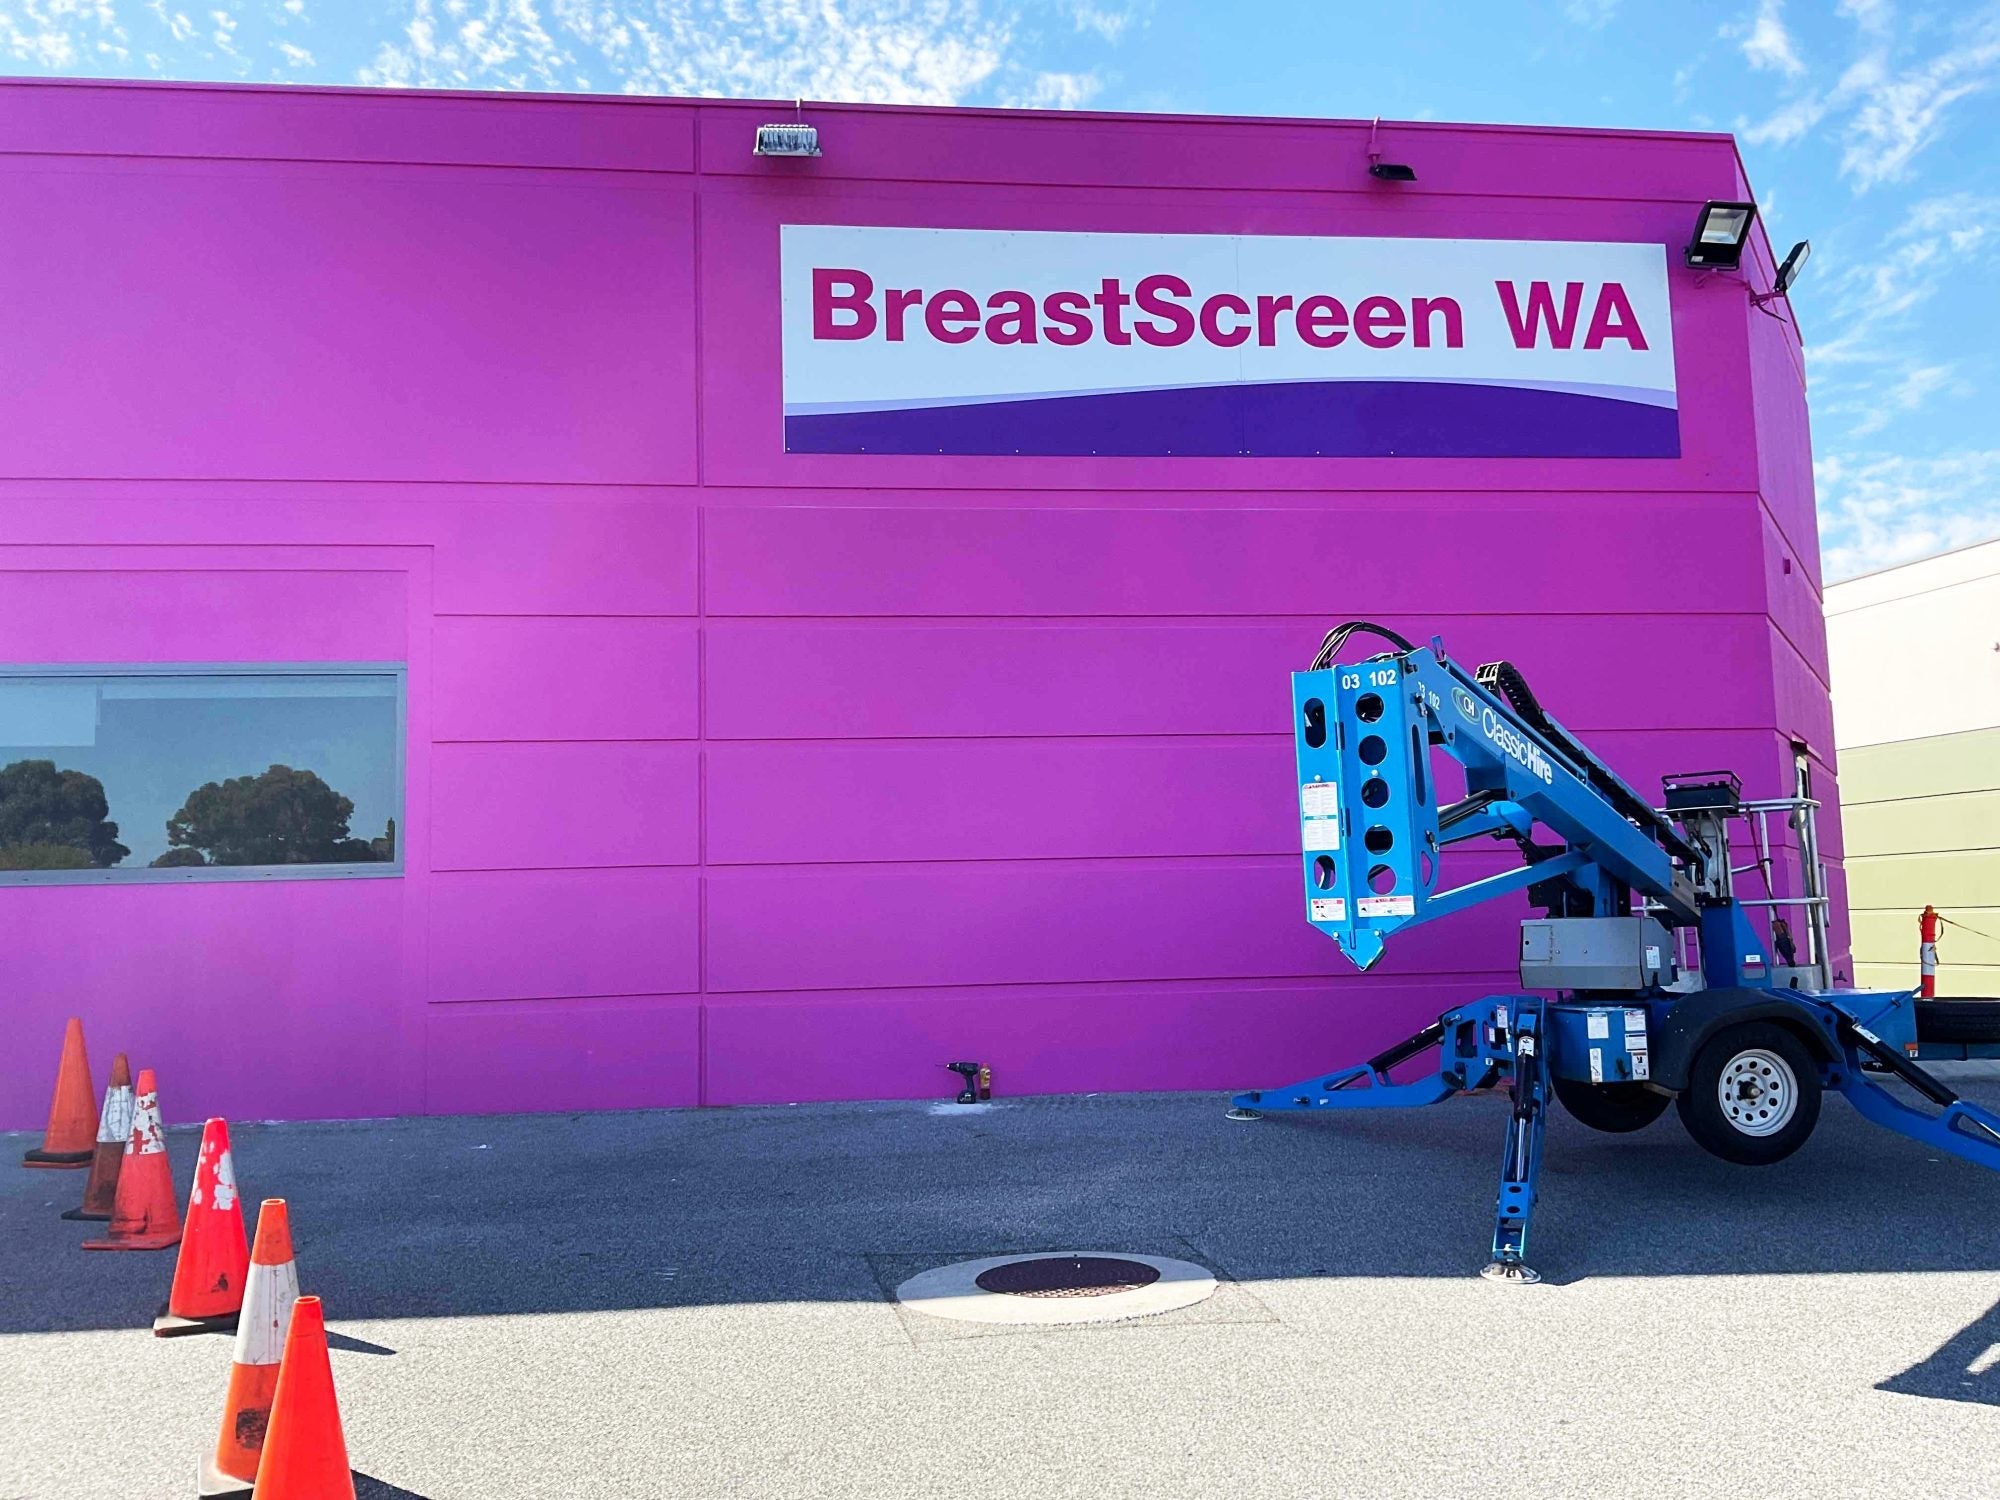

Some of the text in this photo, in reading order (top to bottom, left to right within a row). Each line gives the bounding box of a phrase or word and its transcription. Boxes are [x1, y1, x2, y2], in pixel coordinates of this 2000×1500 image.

[813, 268, 1648, 350] BreastScreen WA
[1341, 669, 1397, 690] 03 102
[1482, 707, 1553, 785] ClassicHire
